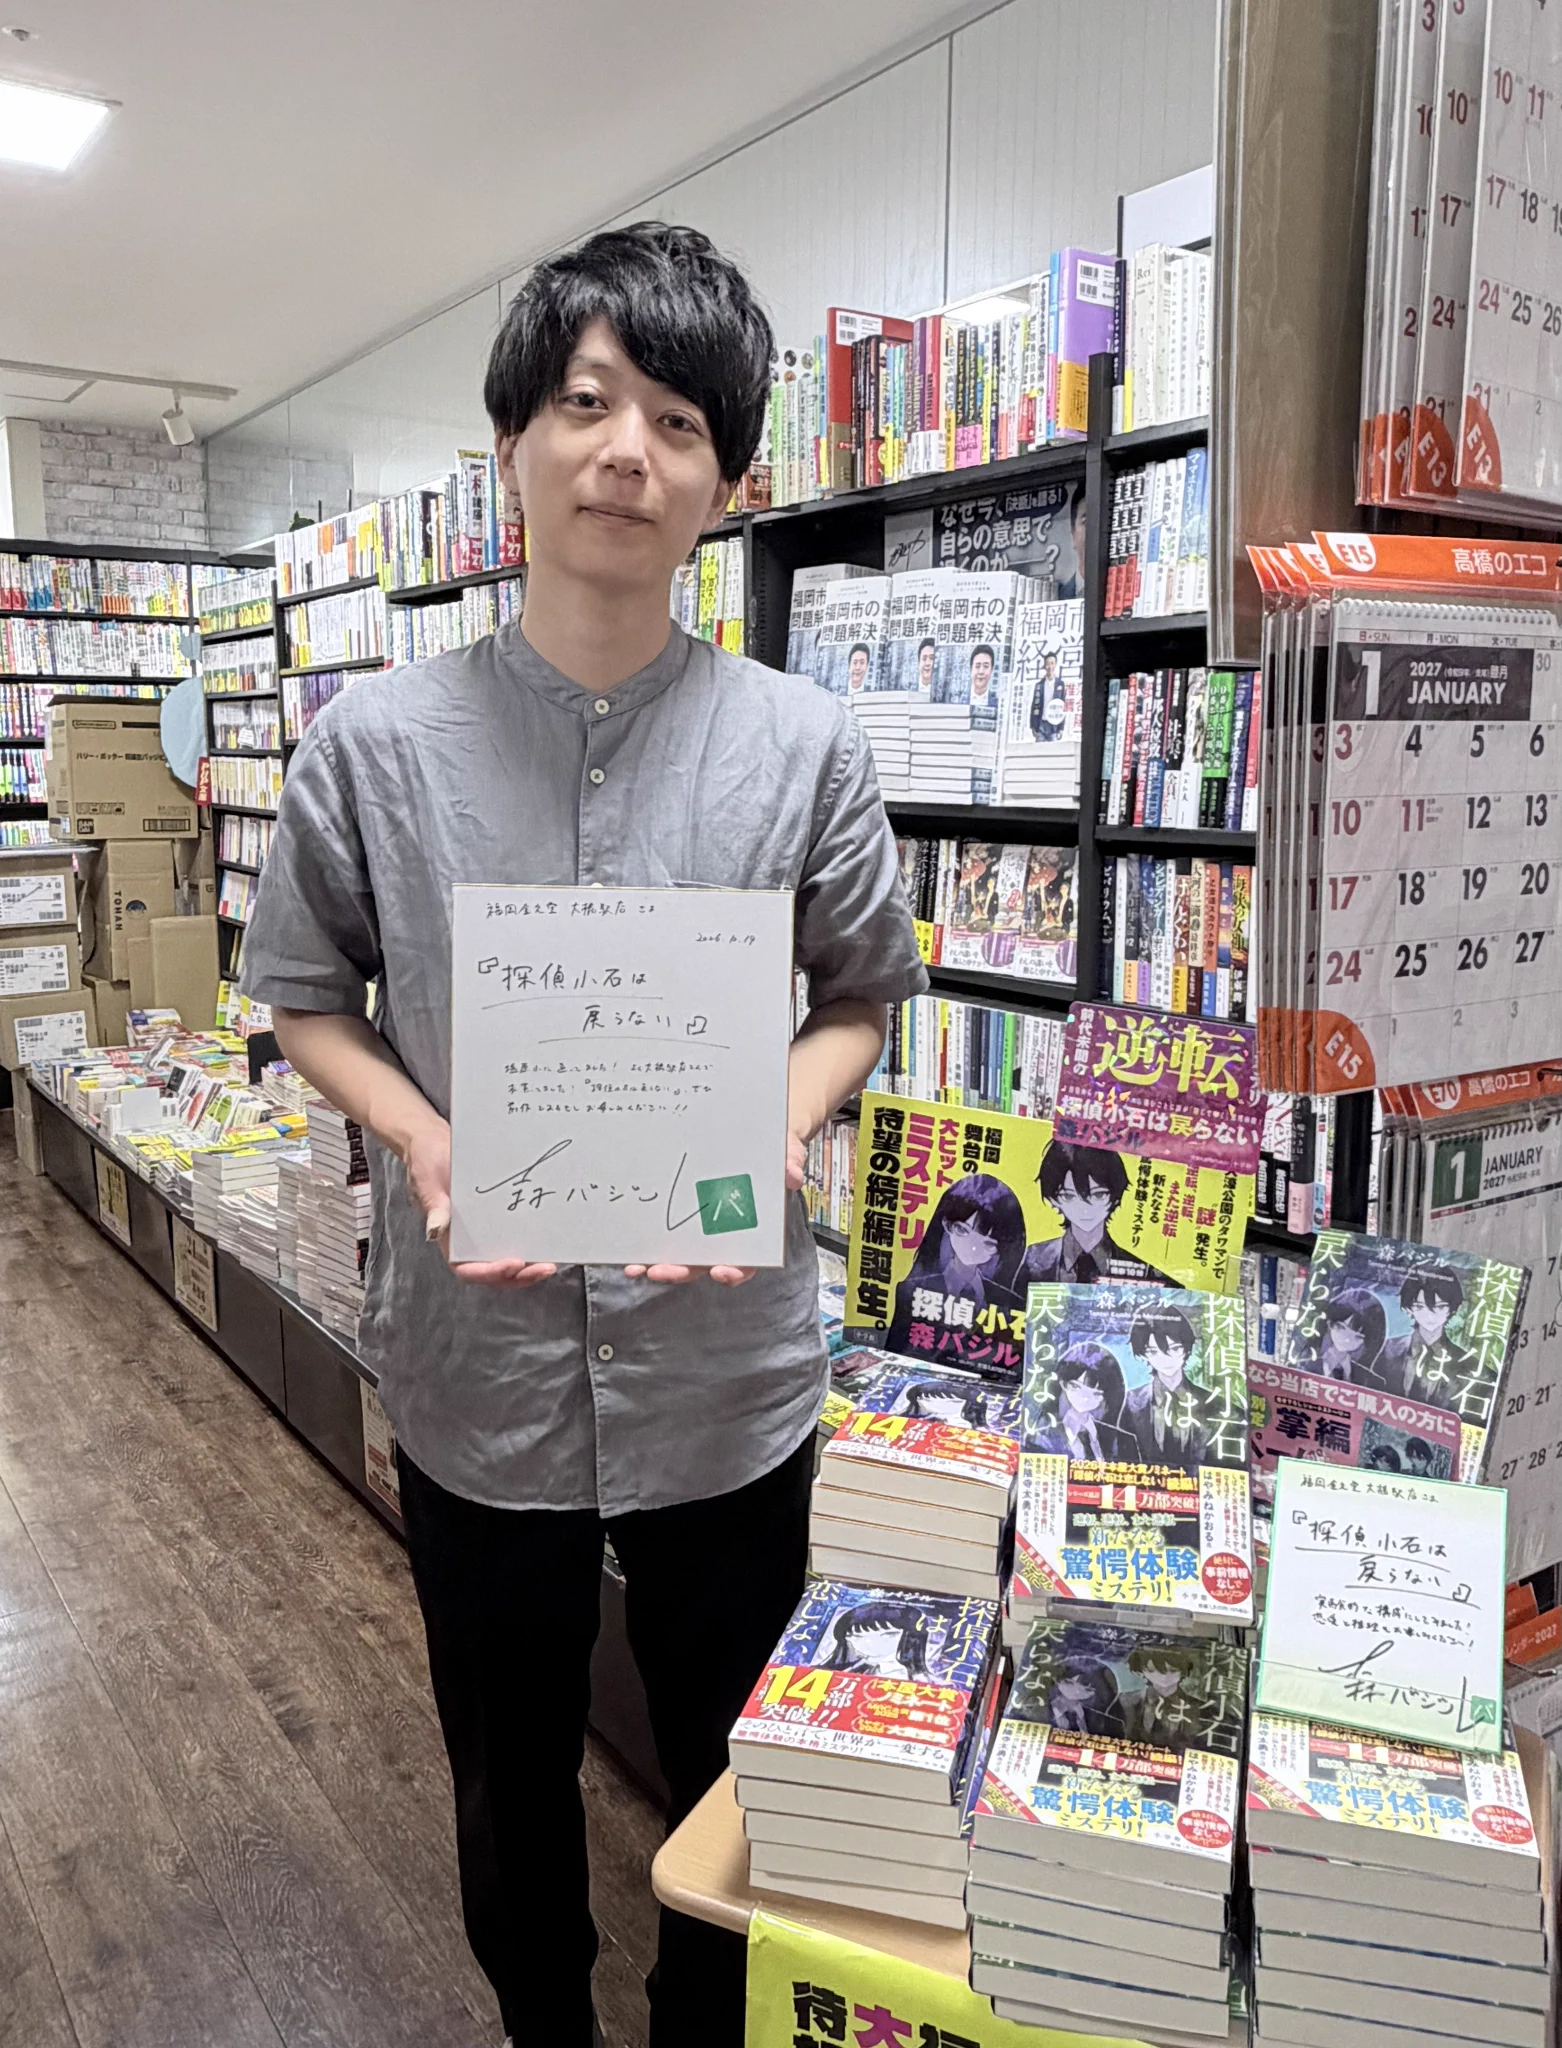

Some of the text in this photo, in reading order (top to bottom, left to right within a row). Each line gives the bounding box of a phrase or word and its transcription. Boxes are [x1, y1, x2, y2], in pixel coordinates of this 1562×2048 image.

[1448, 89, 1468, 124] 10
[1494, 67, 1545, 119] 10 11
[1440, 193, 1461, 227] 17
[1487, 174, 1538, 223] 17 18
[1432, 296, 1455, 330] 24
[1478, 280, 1561, 336] 24 25 26
[1418, 431, 1447, 487] E13
[1467, 423, 1493, 482] E13
[941, 513, 1052, 558] 自らの意思で
[1336, 544, 1374, 564] E15
[1451, 548, 1547, 576] 高橋のエコ
[825, 600, 880, 621] 福岡市の
[939, 598, 1005, 620] 福岡市の
[822, 622, 878, 644] 問題解決
[937, 622, 1003, 644] 問題解決
[1014, 635, 1084, 683] 経営
[1410, 661, 1442, 676] 2027
[1536, 653, 1551, 671] 30
[1361, 651, 1381, 715] 1
[1407, 680, 1506, 704] JANUARY
[1335, 724, 1545, 760] 3 4 5 6
[1332, 794, 1548, 835] 10 11 12 13
[1329, 862, 1549, 910] 17 18 19 20
[113, 891, 123, 931] TOHAN
[478, 957, 647, 991] 『探偵小石は
[1326, 931, 1545, 986] 24 25 26 27
[1073, 1008, 1095, 1076] 前代未聞の
[1092, 1015, 1246, 1099] 逆転
[1325, 1030, 1363, 1079] E15
[1061, 1095, 1259, 1146] 探偵小石は戻らない
[936, 1118, 960, 1188] 大ヒット
[963, 1123, 984, 1173] 舞台の
[983, 1127, 1003, 1164] 福岡
[1484, 1146, 1543, 1175] JANUARY
[898, 1112, 935, 1250] ミステリ
[1450, 1151, 1465, 1200] 1
[1483, 1175, 1506, 1190] 2027
[1150, 1174, 1166, 1223] 新たなる
[856, 1106, 905, 1331] 待望の続編誕生。
[1377, 1245, 1450, 1268] 森バジル
[1548, 1257, 1556, 1275] 7
[1097, 1291, 1173, 1309] 森バジル
[1288, 1231, 1351, 1365] 戻らない
[909, 1322, 1020, 1367] 森バジル
[1451, 1259, 1523, 1421] 探偵小石
[1543, 1323, 1557, 1341] 14
[1025, 1285, 1067, 1436] 戻らない
[1205, 1293, 1248, 1463] 探偵小石
[1417, 1346, 1452, 1383] は
[1165, 1391, 1201, 1429] は
[1507, 1388, 1549, 1416] 20 21
[850, 1412, 908, 1441] 14
[1276, 1407, 1351, 1455] 掌編
[1501, 1447, 1546, 1480] 27 28
[1091, 1527, 1165, 1547] 新たなる
[1061, 1548, 1199, 1580] 驚愕体験
[1093, 1581, 1172, 1603] ミステリ!
[777, 1579, 841, 1656] 恋しない
[916, 1613, 948, 1633] は
[941, 1597, 998, 1687] 探偵小石
[1011, 1618, 1070, 1709] 戻らない
[763, 1666, 833, 1711] 14
[824, 1677, 860, 1708] 万部
[1198, 1642, 1248, 1752] 探偵小石
[759, 1703, 840, 1728] 突破!!
[1155, 1696, 1192, 1723] は
[1031, 1786, 1174, 1825] 驚愕体験
[1304, 1780, 1469, 1822] 驚愕体験
[1060, 1813, 1143, 1838] ミステリ!
[1344, 1810, 1437, 1834] ミステリ!
[792, 1981, 848, 2048] 待
